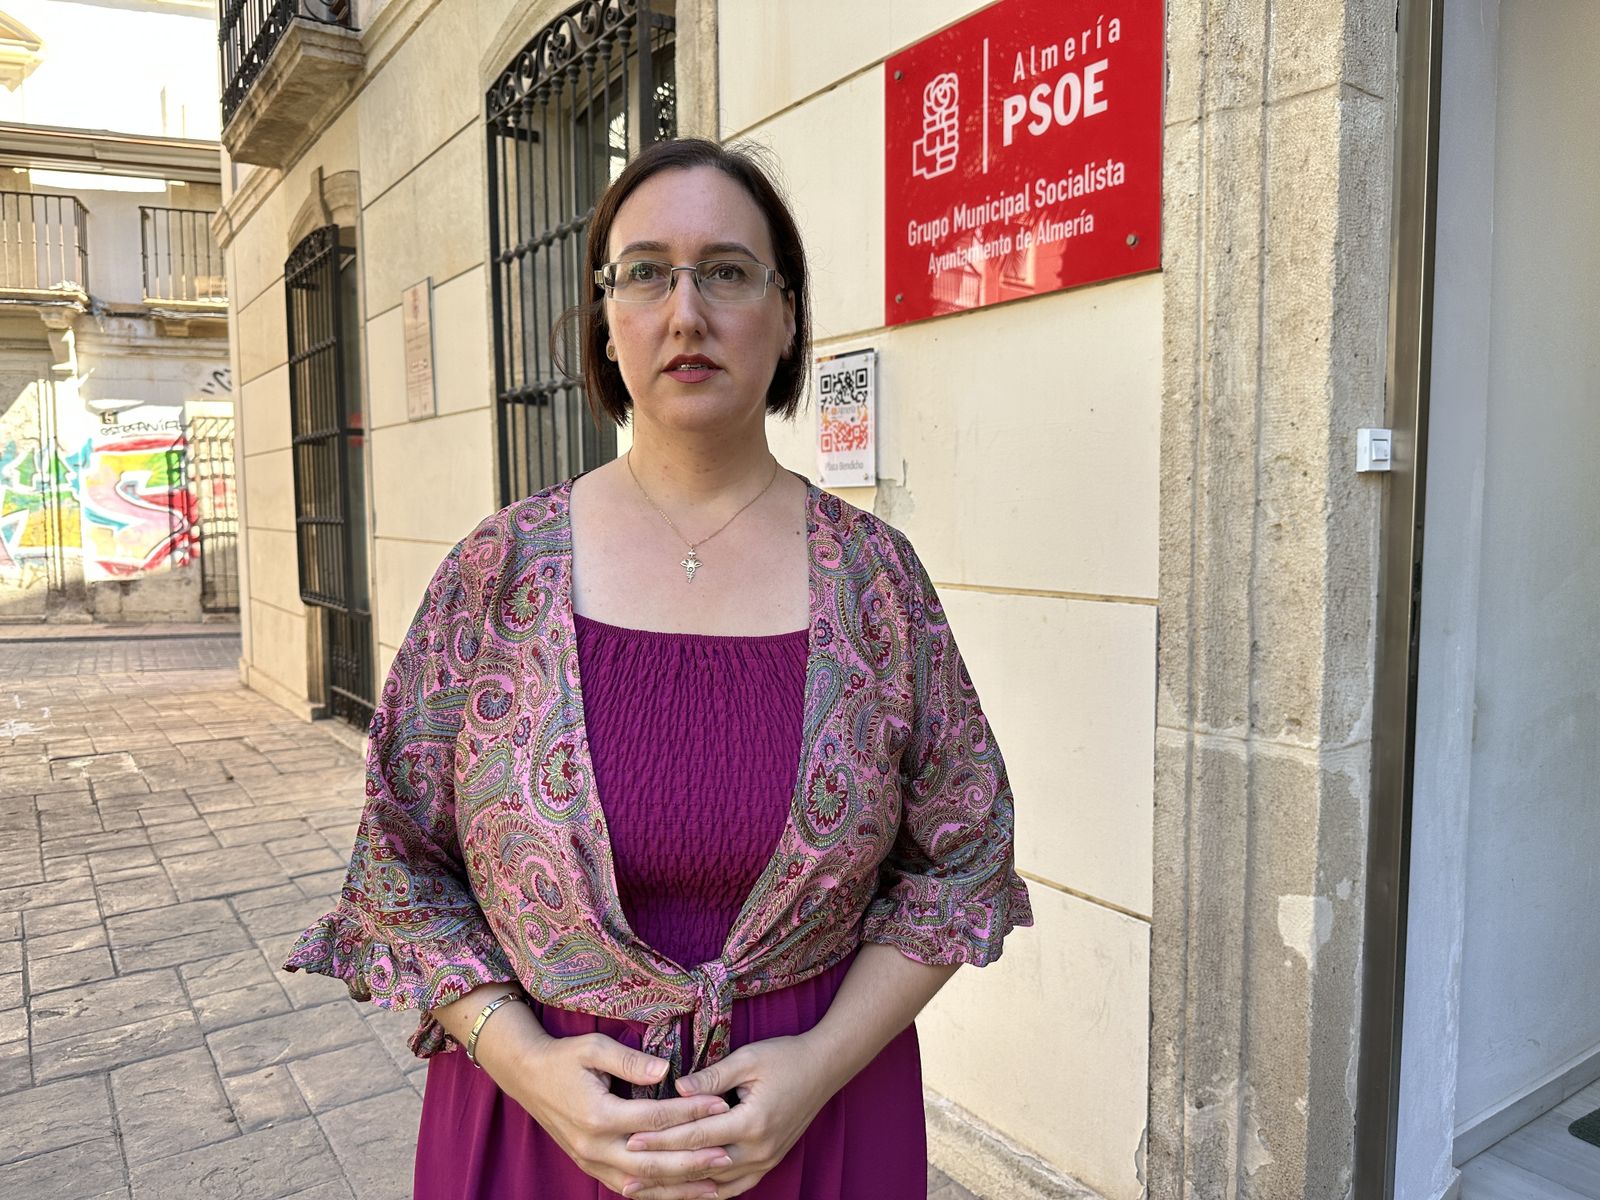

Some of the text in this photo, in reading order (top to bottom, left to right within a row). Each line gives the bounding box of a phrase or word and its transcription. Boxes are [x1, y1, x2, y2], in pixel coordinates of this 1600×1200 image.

[1013, 15, 1121, 83] Almería
[1003, 58, 1109, 147] PSOE
[907, 157, 1126, 248] Grupo Municipal Socialista
[927, 209, 1095, 278] Ayuntamiento de Almería
